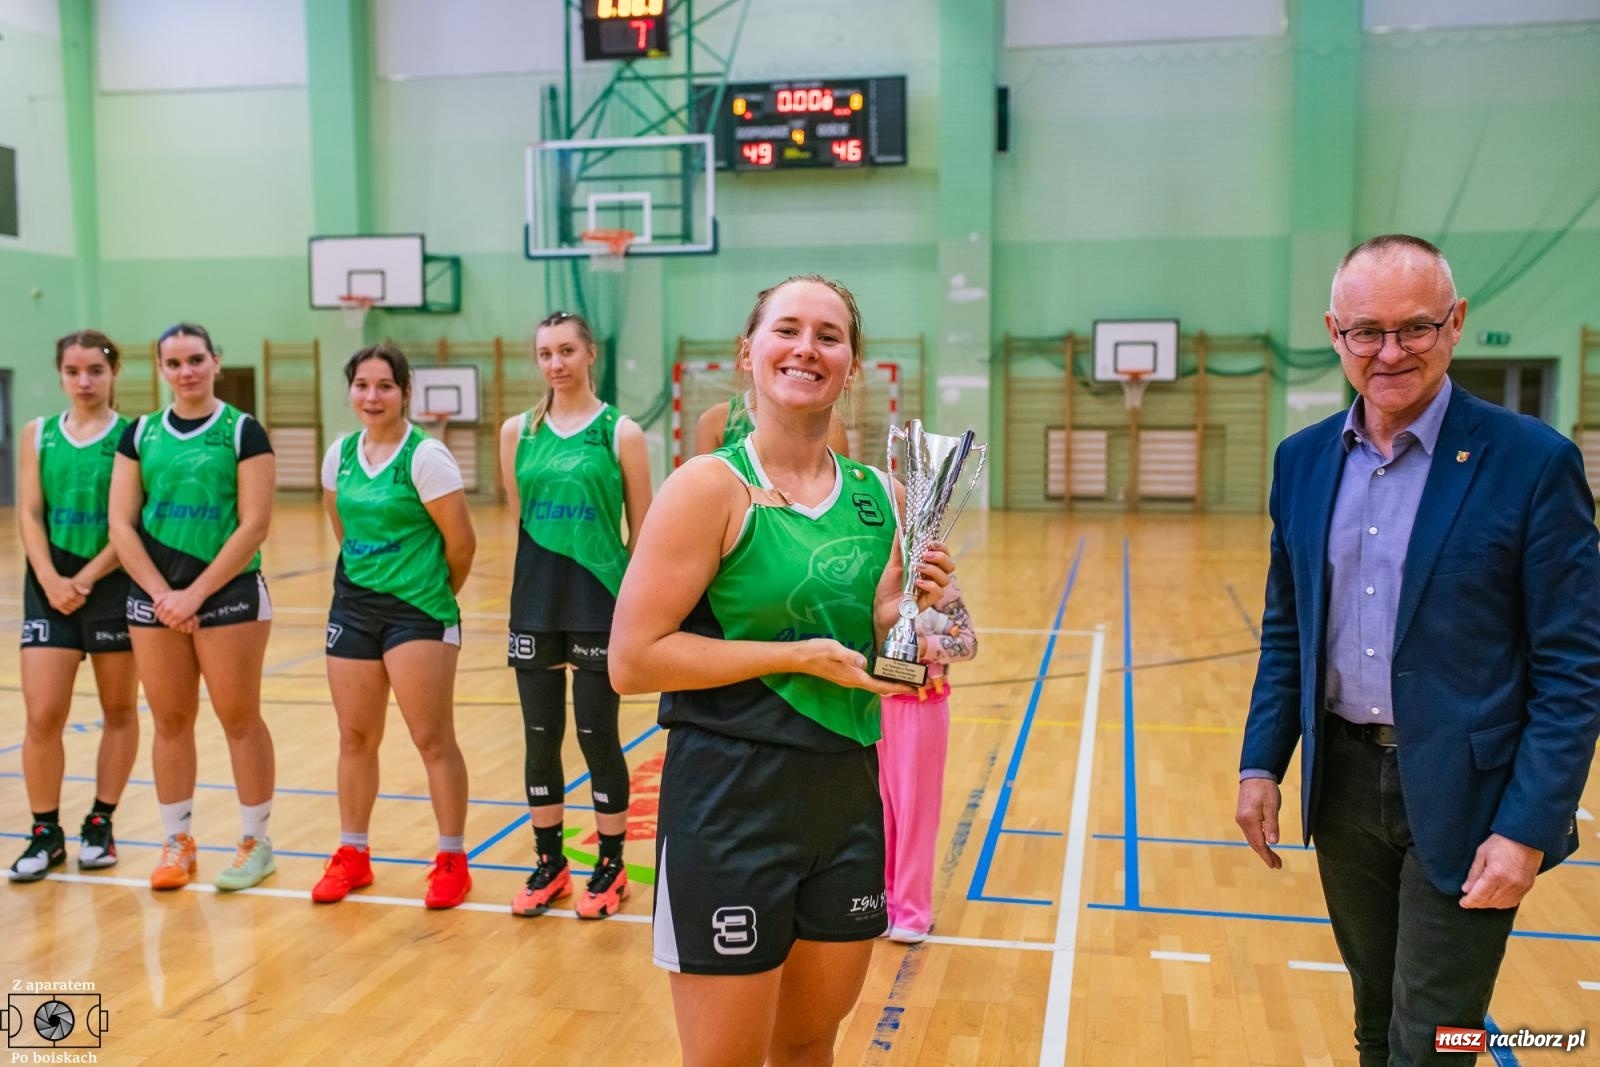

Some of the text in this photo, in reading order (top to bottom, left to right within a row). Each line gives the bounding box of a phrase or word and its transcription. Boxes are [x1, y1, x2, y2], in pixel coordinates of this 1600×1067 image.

[629, 20, 647, 49] 7
[743, 143, 772, 165] 49
[832, 140, 862, 161] 46
[155, 500, 221, 520] Clavis
[535, 500, 597, 521] Clavis
[852, 492, 885, 527] 3
[711, 905, 758, 955] 3
